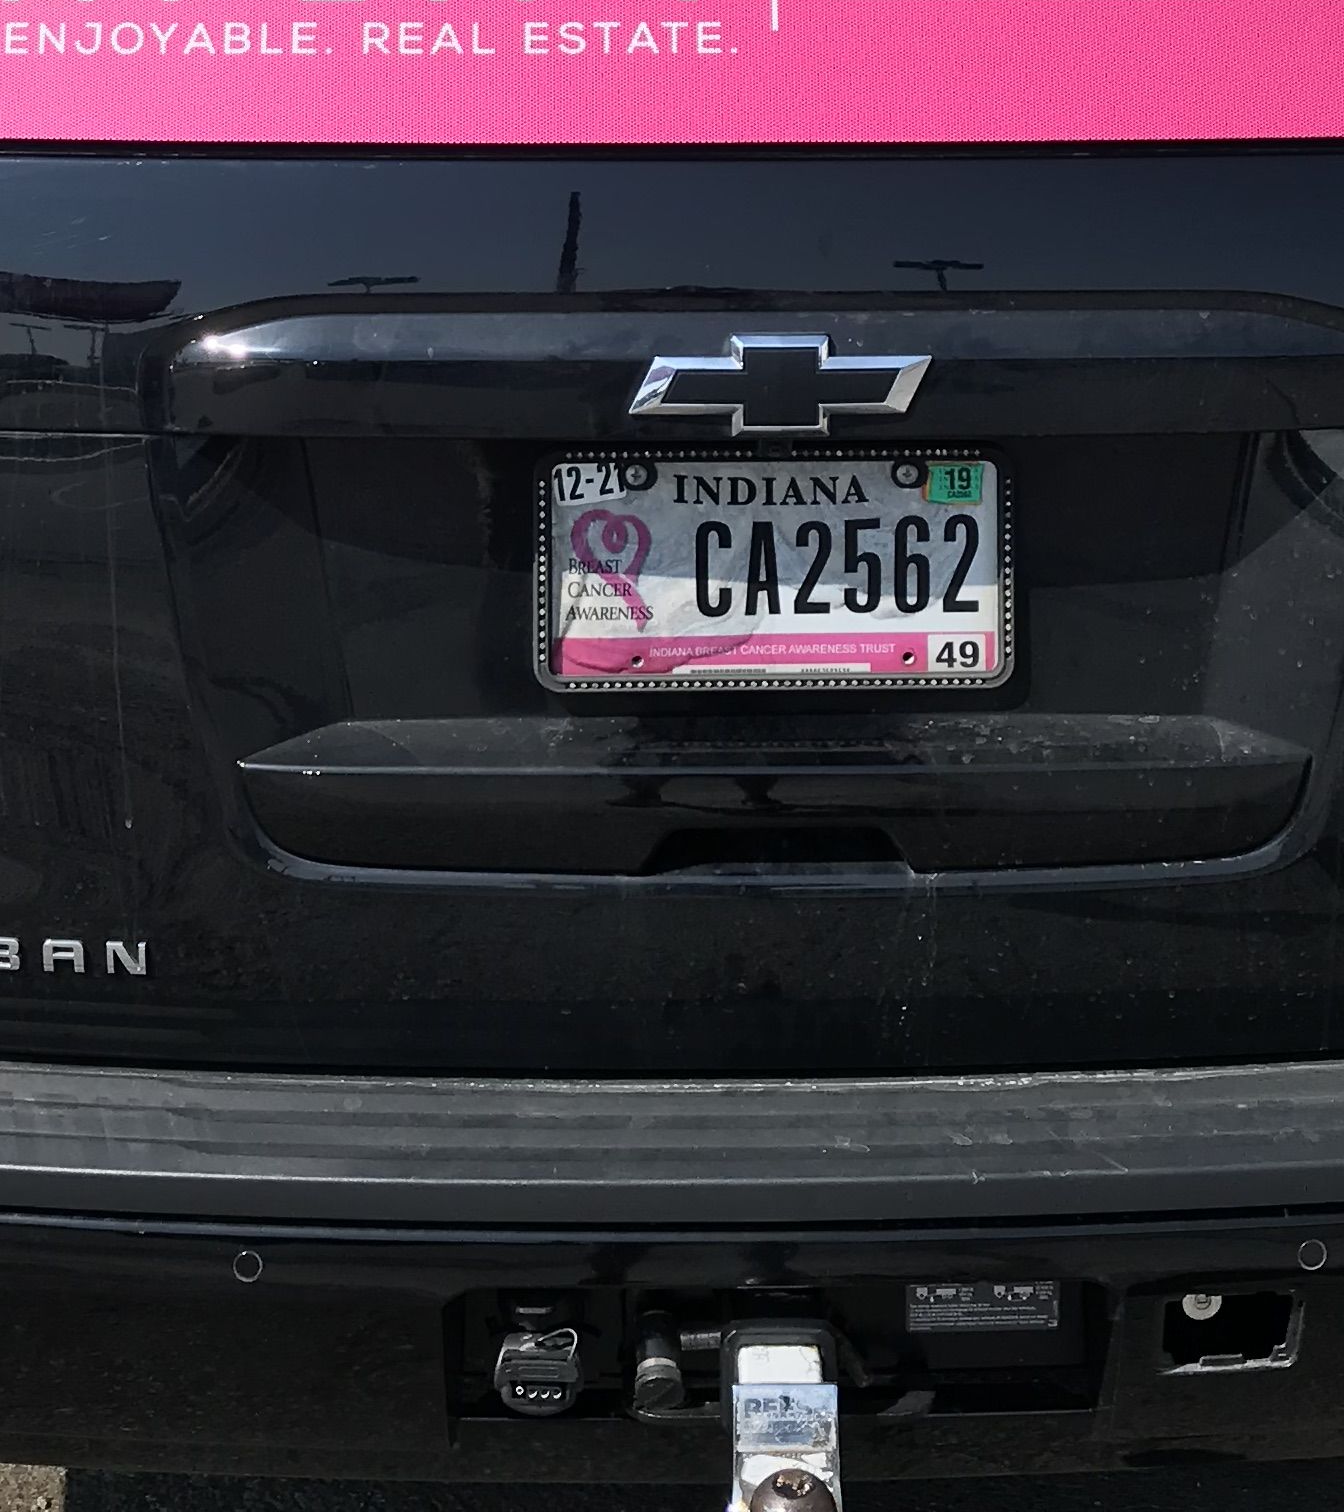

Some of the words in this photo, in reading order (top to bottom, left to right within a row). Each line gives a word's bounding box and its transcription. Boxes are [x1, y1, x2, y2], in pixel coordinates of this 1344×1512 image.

[3, 20, 334, 56] ENJOYABLE.
[362, 20, 496, 56] REAL
[523, 20, 739, 56] ESTATE.
[672, 473, 869, 506] INDIANA
[944, 467, 972, 490] 19
[568, 557, 623, 576] BREAST
[694, 513, 981, 619] CA2562
[567, 580, 633, 599] CANCER
[561, 604, 655, 622] AWARENESS
[649, 645, 695, 658] INDIANA
[695, 644, 738, 657] BREAST
[740, 643, 788, 656] CANCER
[788, 642, 858, 655] AWARENESS
[859, 642, 897, 654] TRUST
[935, 640, 981, 669] 49
